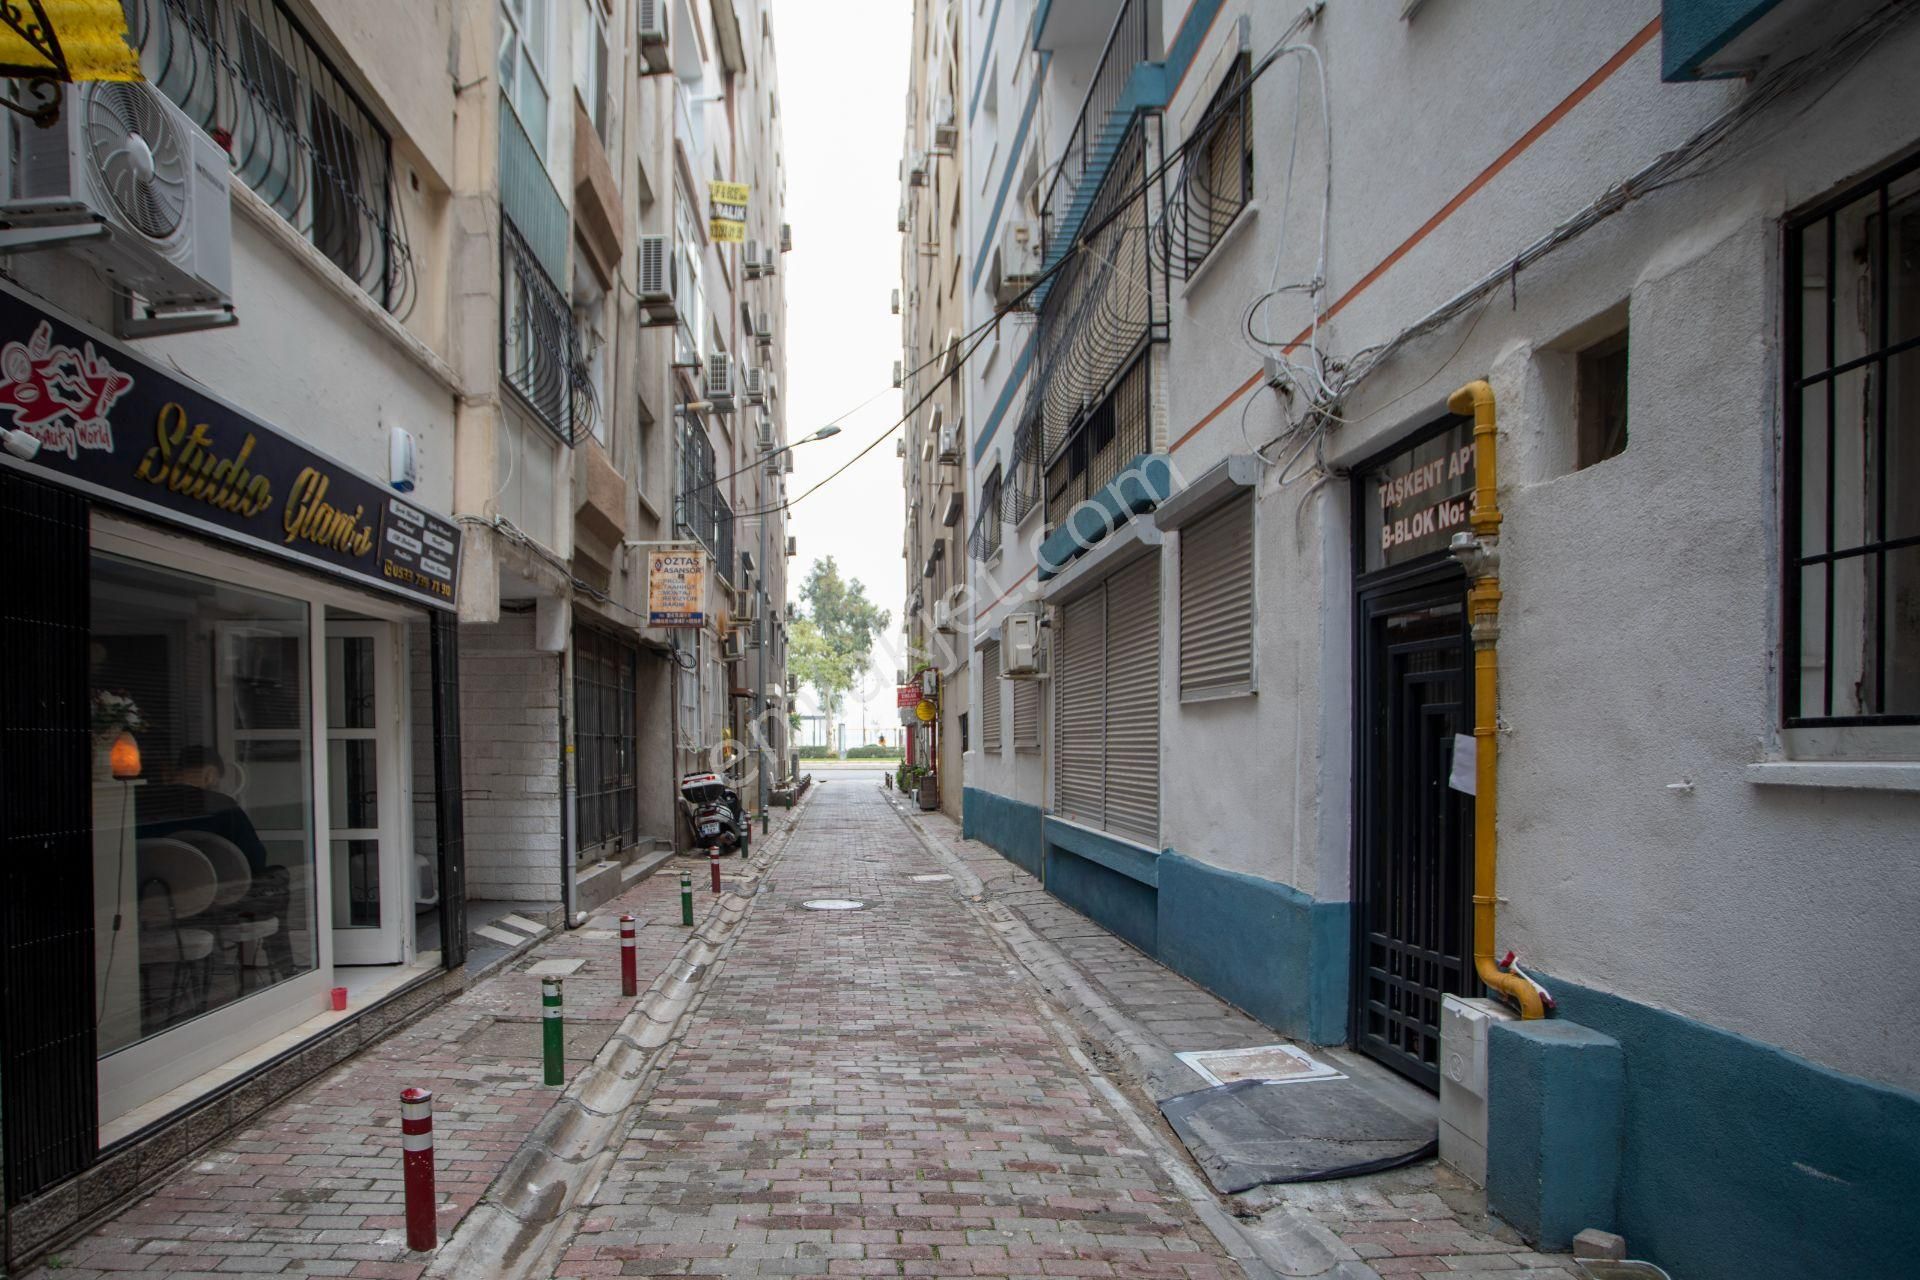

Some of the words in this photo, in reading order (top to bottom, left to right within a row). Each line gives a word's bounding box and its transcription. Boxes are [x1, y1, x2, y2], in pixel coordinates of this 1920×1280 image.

[134, 402, 272, 518] Studio
[1378, 458, 1445, 508] TAŞKENT
[1381, 507, 1435, 550] B-BLOK
[1438, 500, 1465, 530] No:
